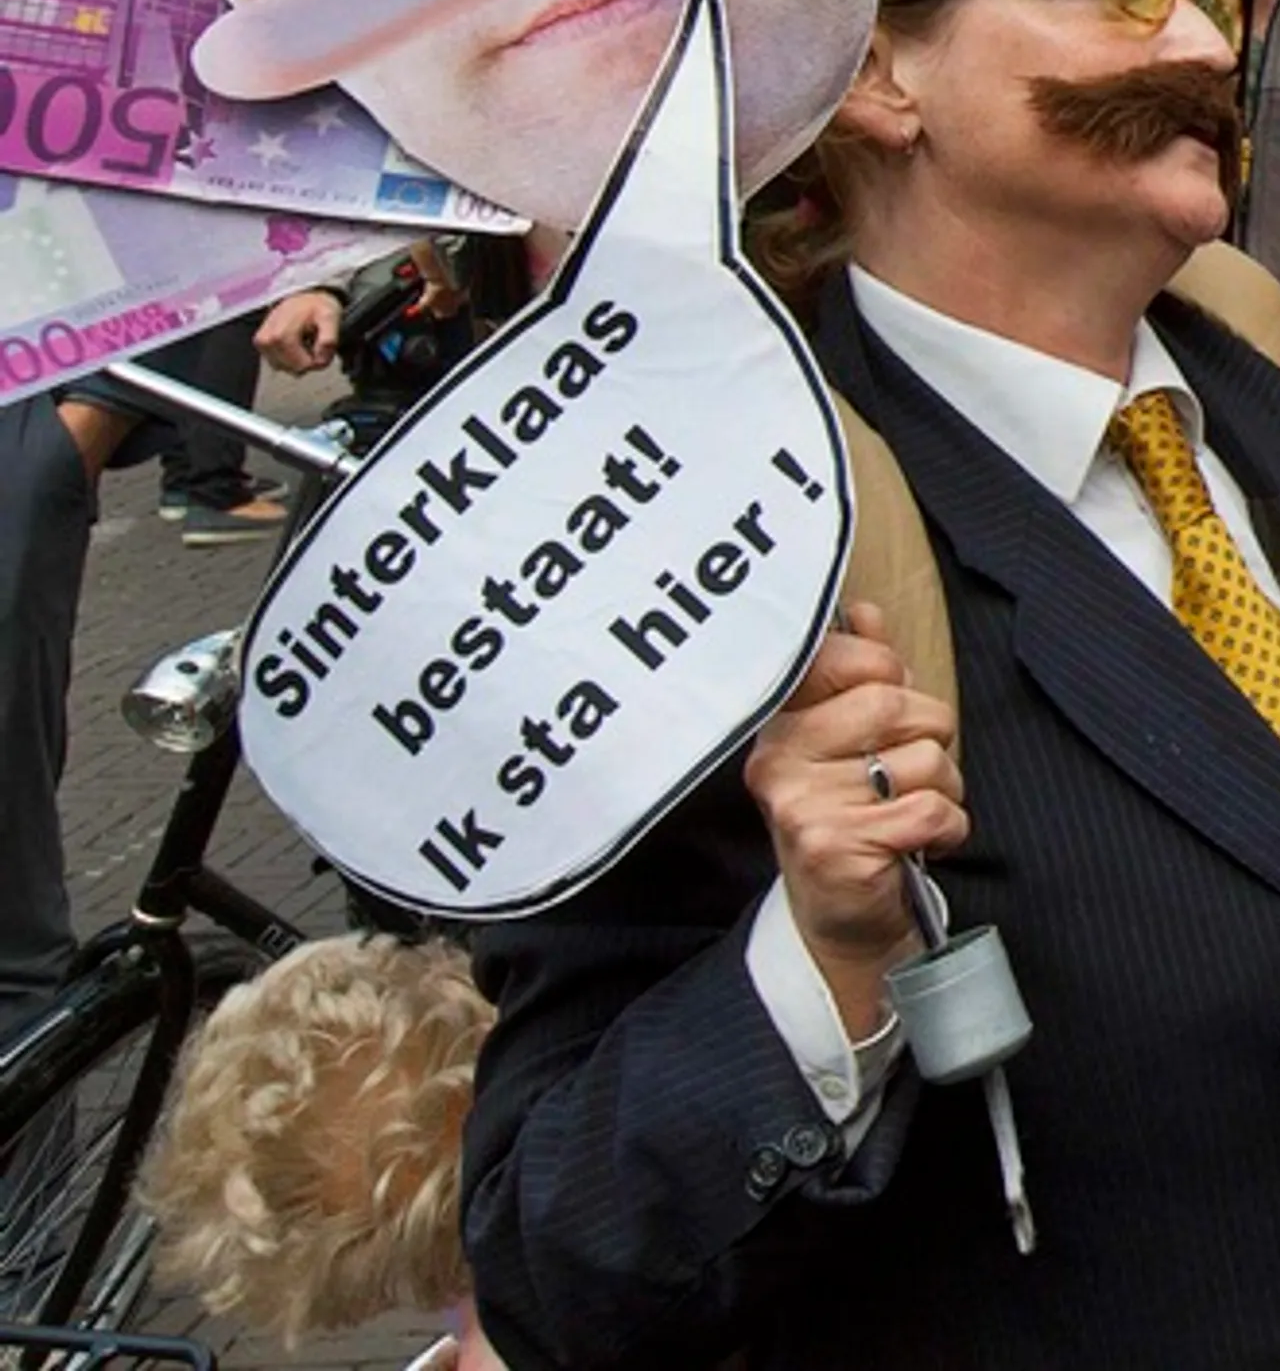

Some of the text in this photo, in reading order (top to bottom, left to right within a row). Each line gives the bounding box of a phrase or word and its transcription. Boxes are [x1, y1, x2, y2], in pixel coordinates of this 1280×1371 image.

[254, 300, 638, 718] Sinterklaas
[372, 425, 681, 756] bestaat!
[418, 808, 505, 893] Ik
[497, 681, 619, 807] sta
[608, 502, 775, 671] hier
